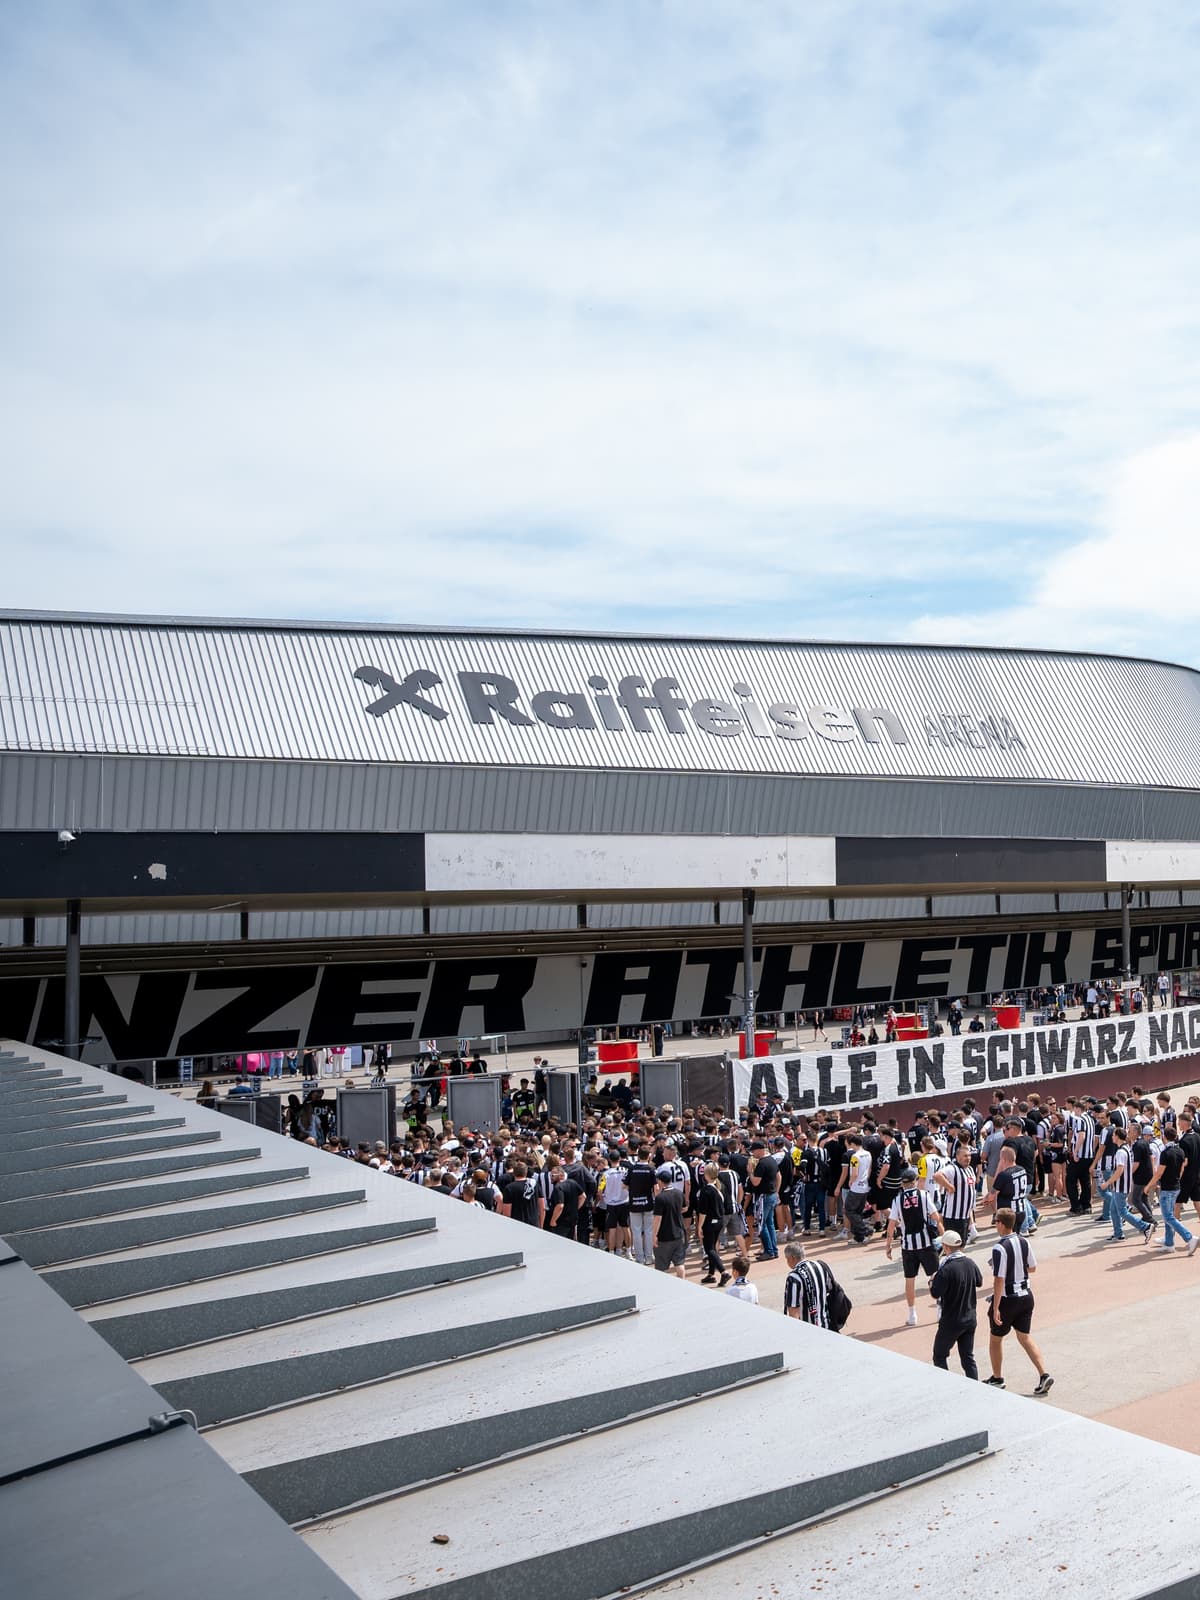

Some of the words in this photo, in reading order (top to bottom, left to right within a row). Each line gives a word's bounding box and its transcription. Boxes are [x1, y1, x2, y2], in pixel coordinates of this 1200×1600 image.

[457, 671, 909, 746] Raiffeisen
[924, 711, 1028, 751] ARENA
[583, 931, 1072, 1027] ATHLETIK
[748, 1050, 878, 1111] ALLE
[895, 1043, 946, 1097] IN
[962, 1020, 1137, 1087] SCHWARZ
[671, 1166, 684, 1182] 12
[1012, 1175, 1027, 1200] 19
